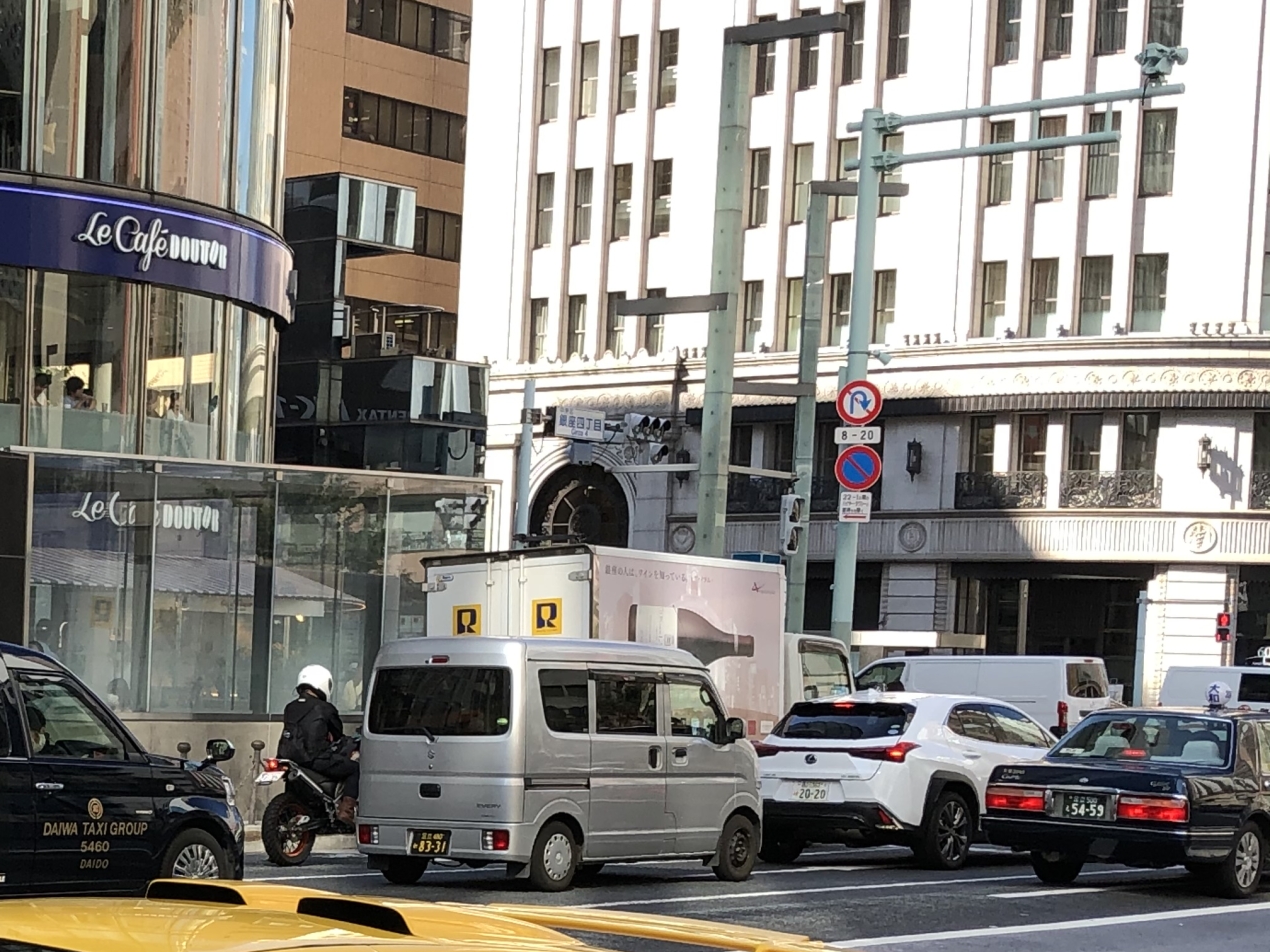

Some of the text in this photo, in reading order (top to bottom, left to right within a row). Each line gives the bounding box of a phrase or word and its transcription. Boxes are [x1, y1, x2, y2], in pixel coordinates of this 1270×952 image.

[77, 211, 228, 272] Le Café DOUTOR
[558, 413, 602, 432] 銀座四丁目
[71, 491, 107, 523] Le
[162, 503, 220, 533] DOUTOR
[1207, 683, 1221, 703] 大和
[799, 788, 826, 800] 20-20
[1071, 802, 1105, 818] 54-59
[43, 822, 148, 836] DAIWA TAXI GROUP
[80, 841, 110, 852] 5460
[418, 840, 446, 853] 83-31
[80, 859, 110, 869] DAIDO
